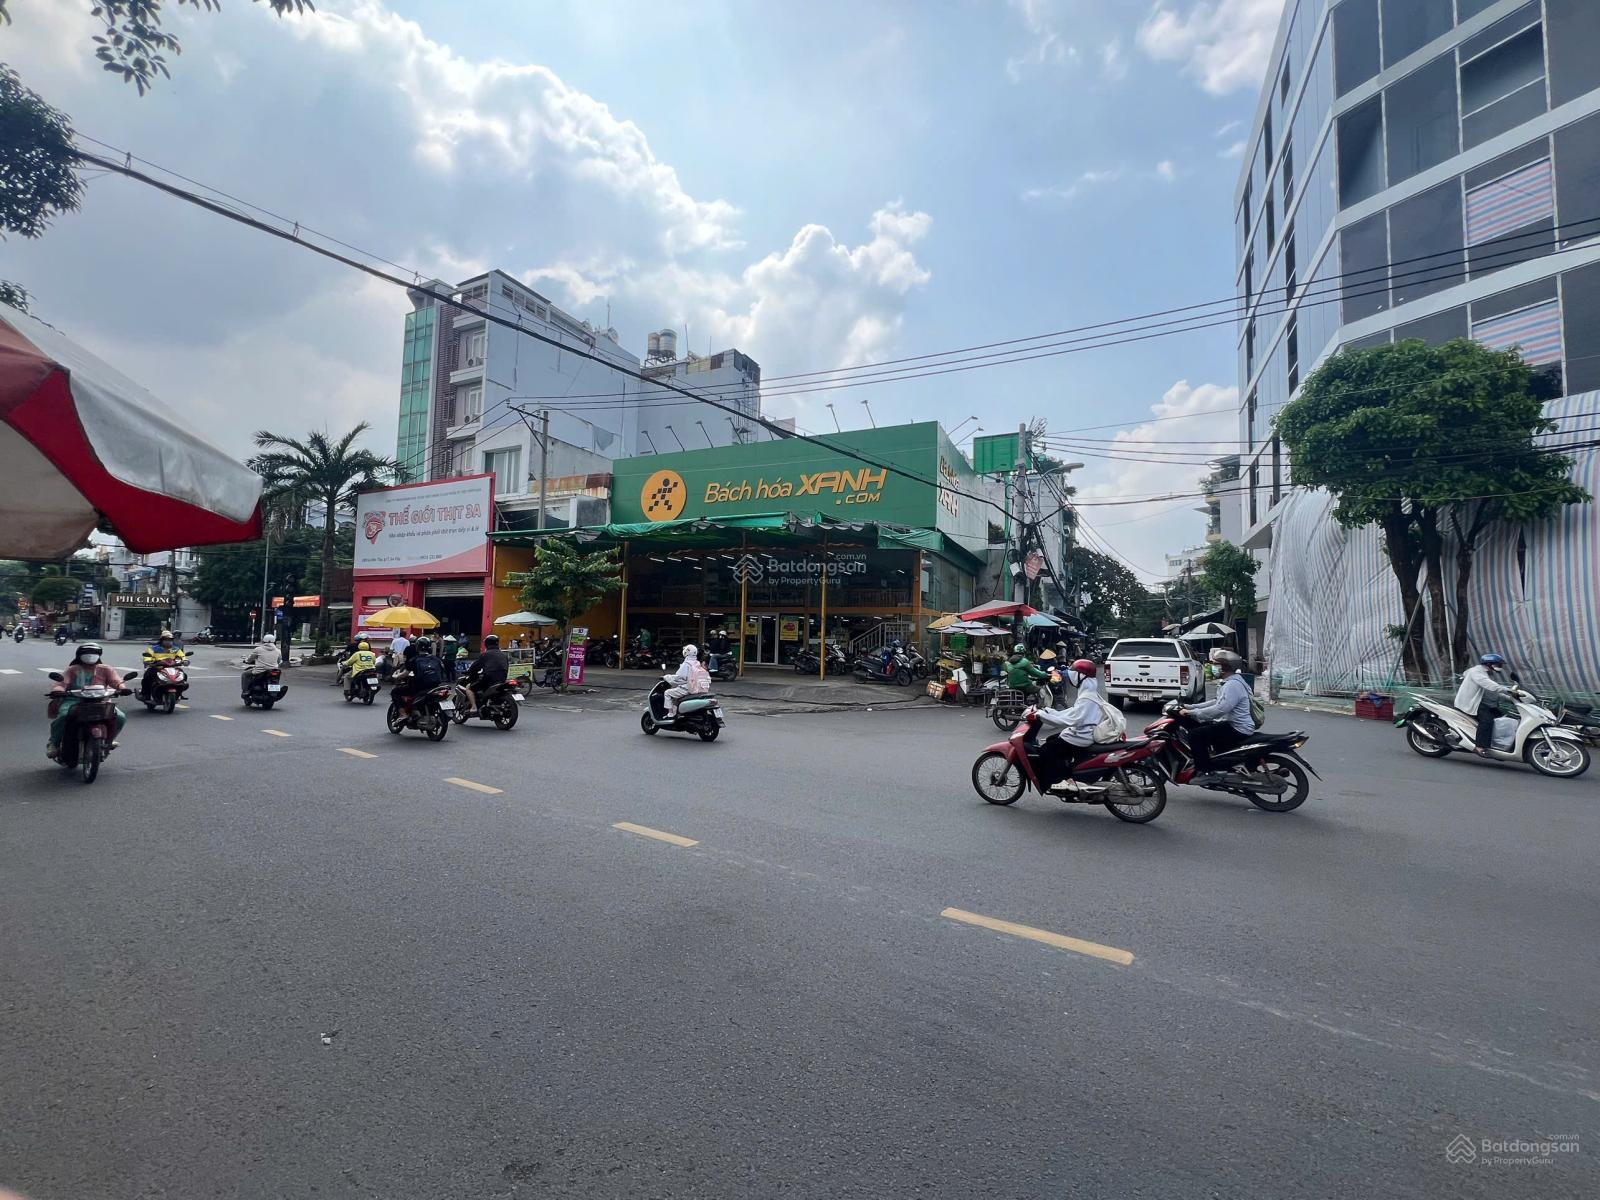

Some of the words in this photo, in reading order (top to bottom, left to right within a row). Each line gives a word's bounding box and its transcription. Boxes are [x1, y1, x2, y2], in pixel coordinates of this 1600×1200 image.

[704, 480, 751, 503] Bách
[755, 476, 793, 499] hóa
[796, 468, 888, 496] XANH
[388, 504, 410, 526] THẾ
[411, 504, 435, 525] GIỚI
[437, 504, 464, 524] THỊT
[466, 503, 481, 519] 3A
[359, 653, 372, 662] be
